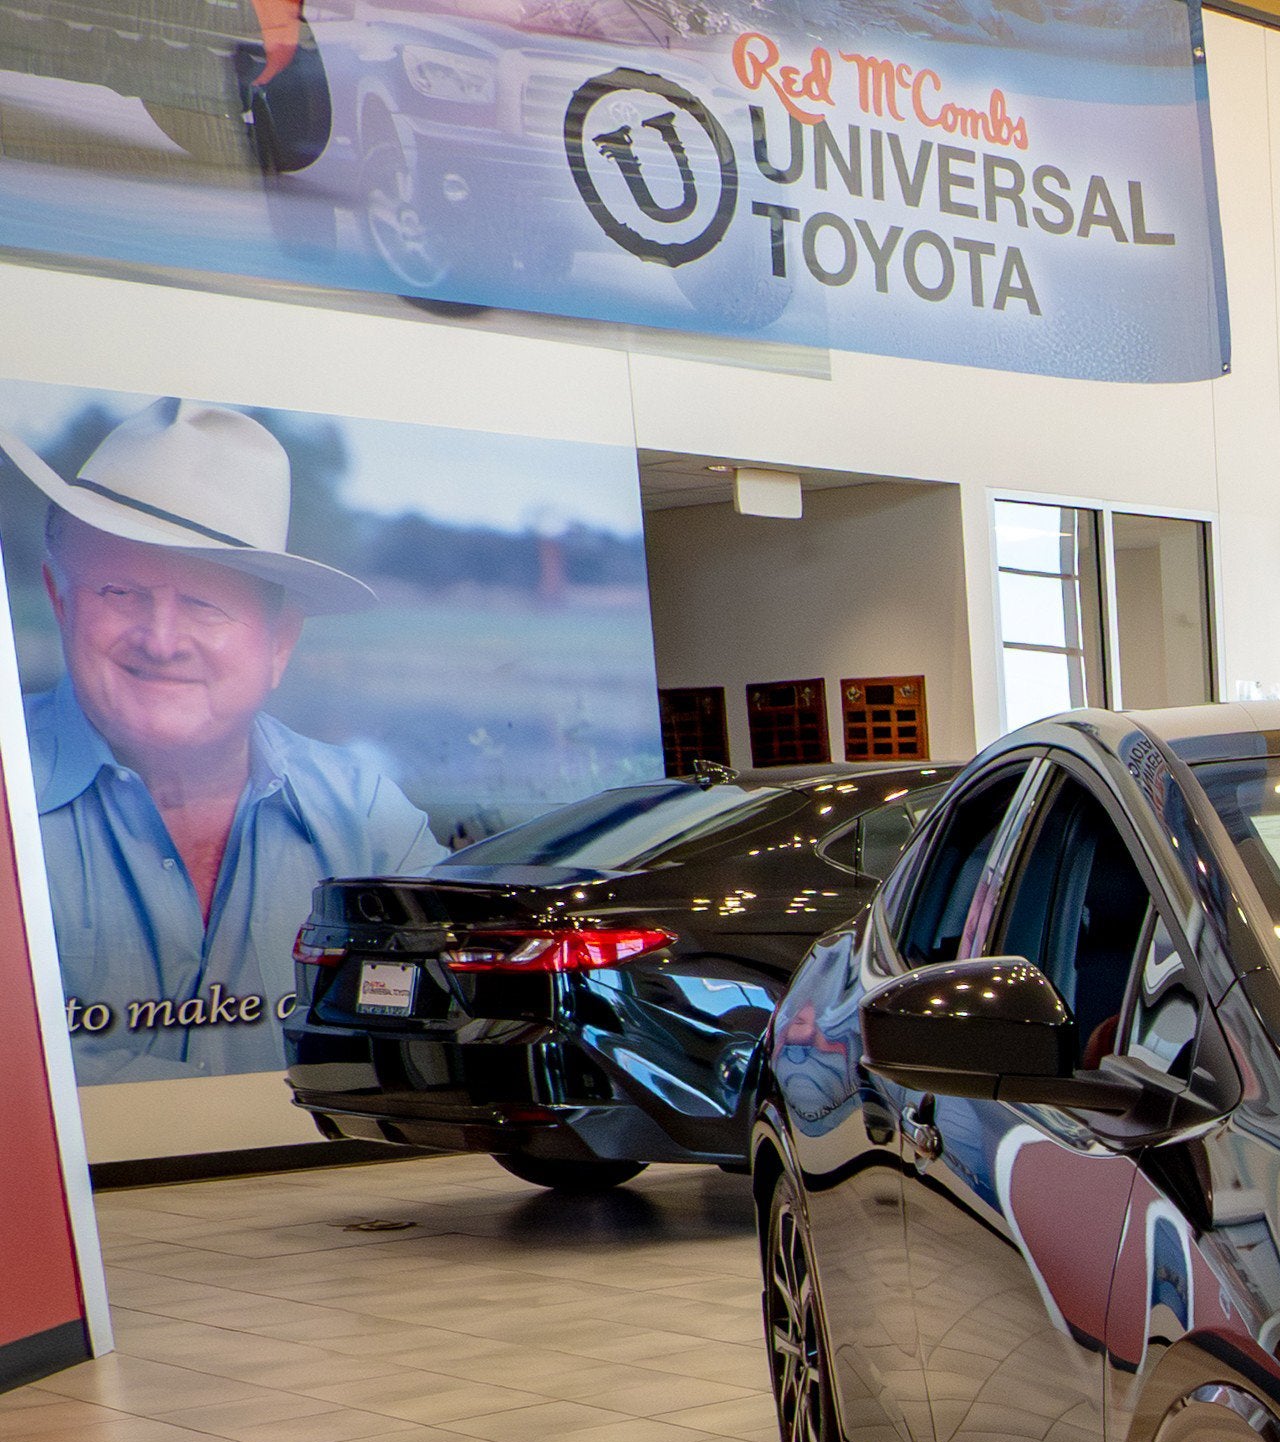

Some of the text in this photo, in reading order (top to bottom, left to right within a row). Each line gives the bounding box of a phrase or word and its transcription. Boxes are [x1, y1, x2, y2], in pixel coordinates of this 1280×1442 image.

[732, 32, 1029, 150] Red McCombs
[749, 104, 1176, 246] UNIVERSAL
[751, 201, 1042, 316] TOYOTA
[66, 998, 110, 1032] to
[128, 984, 261, 1029] make
